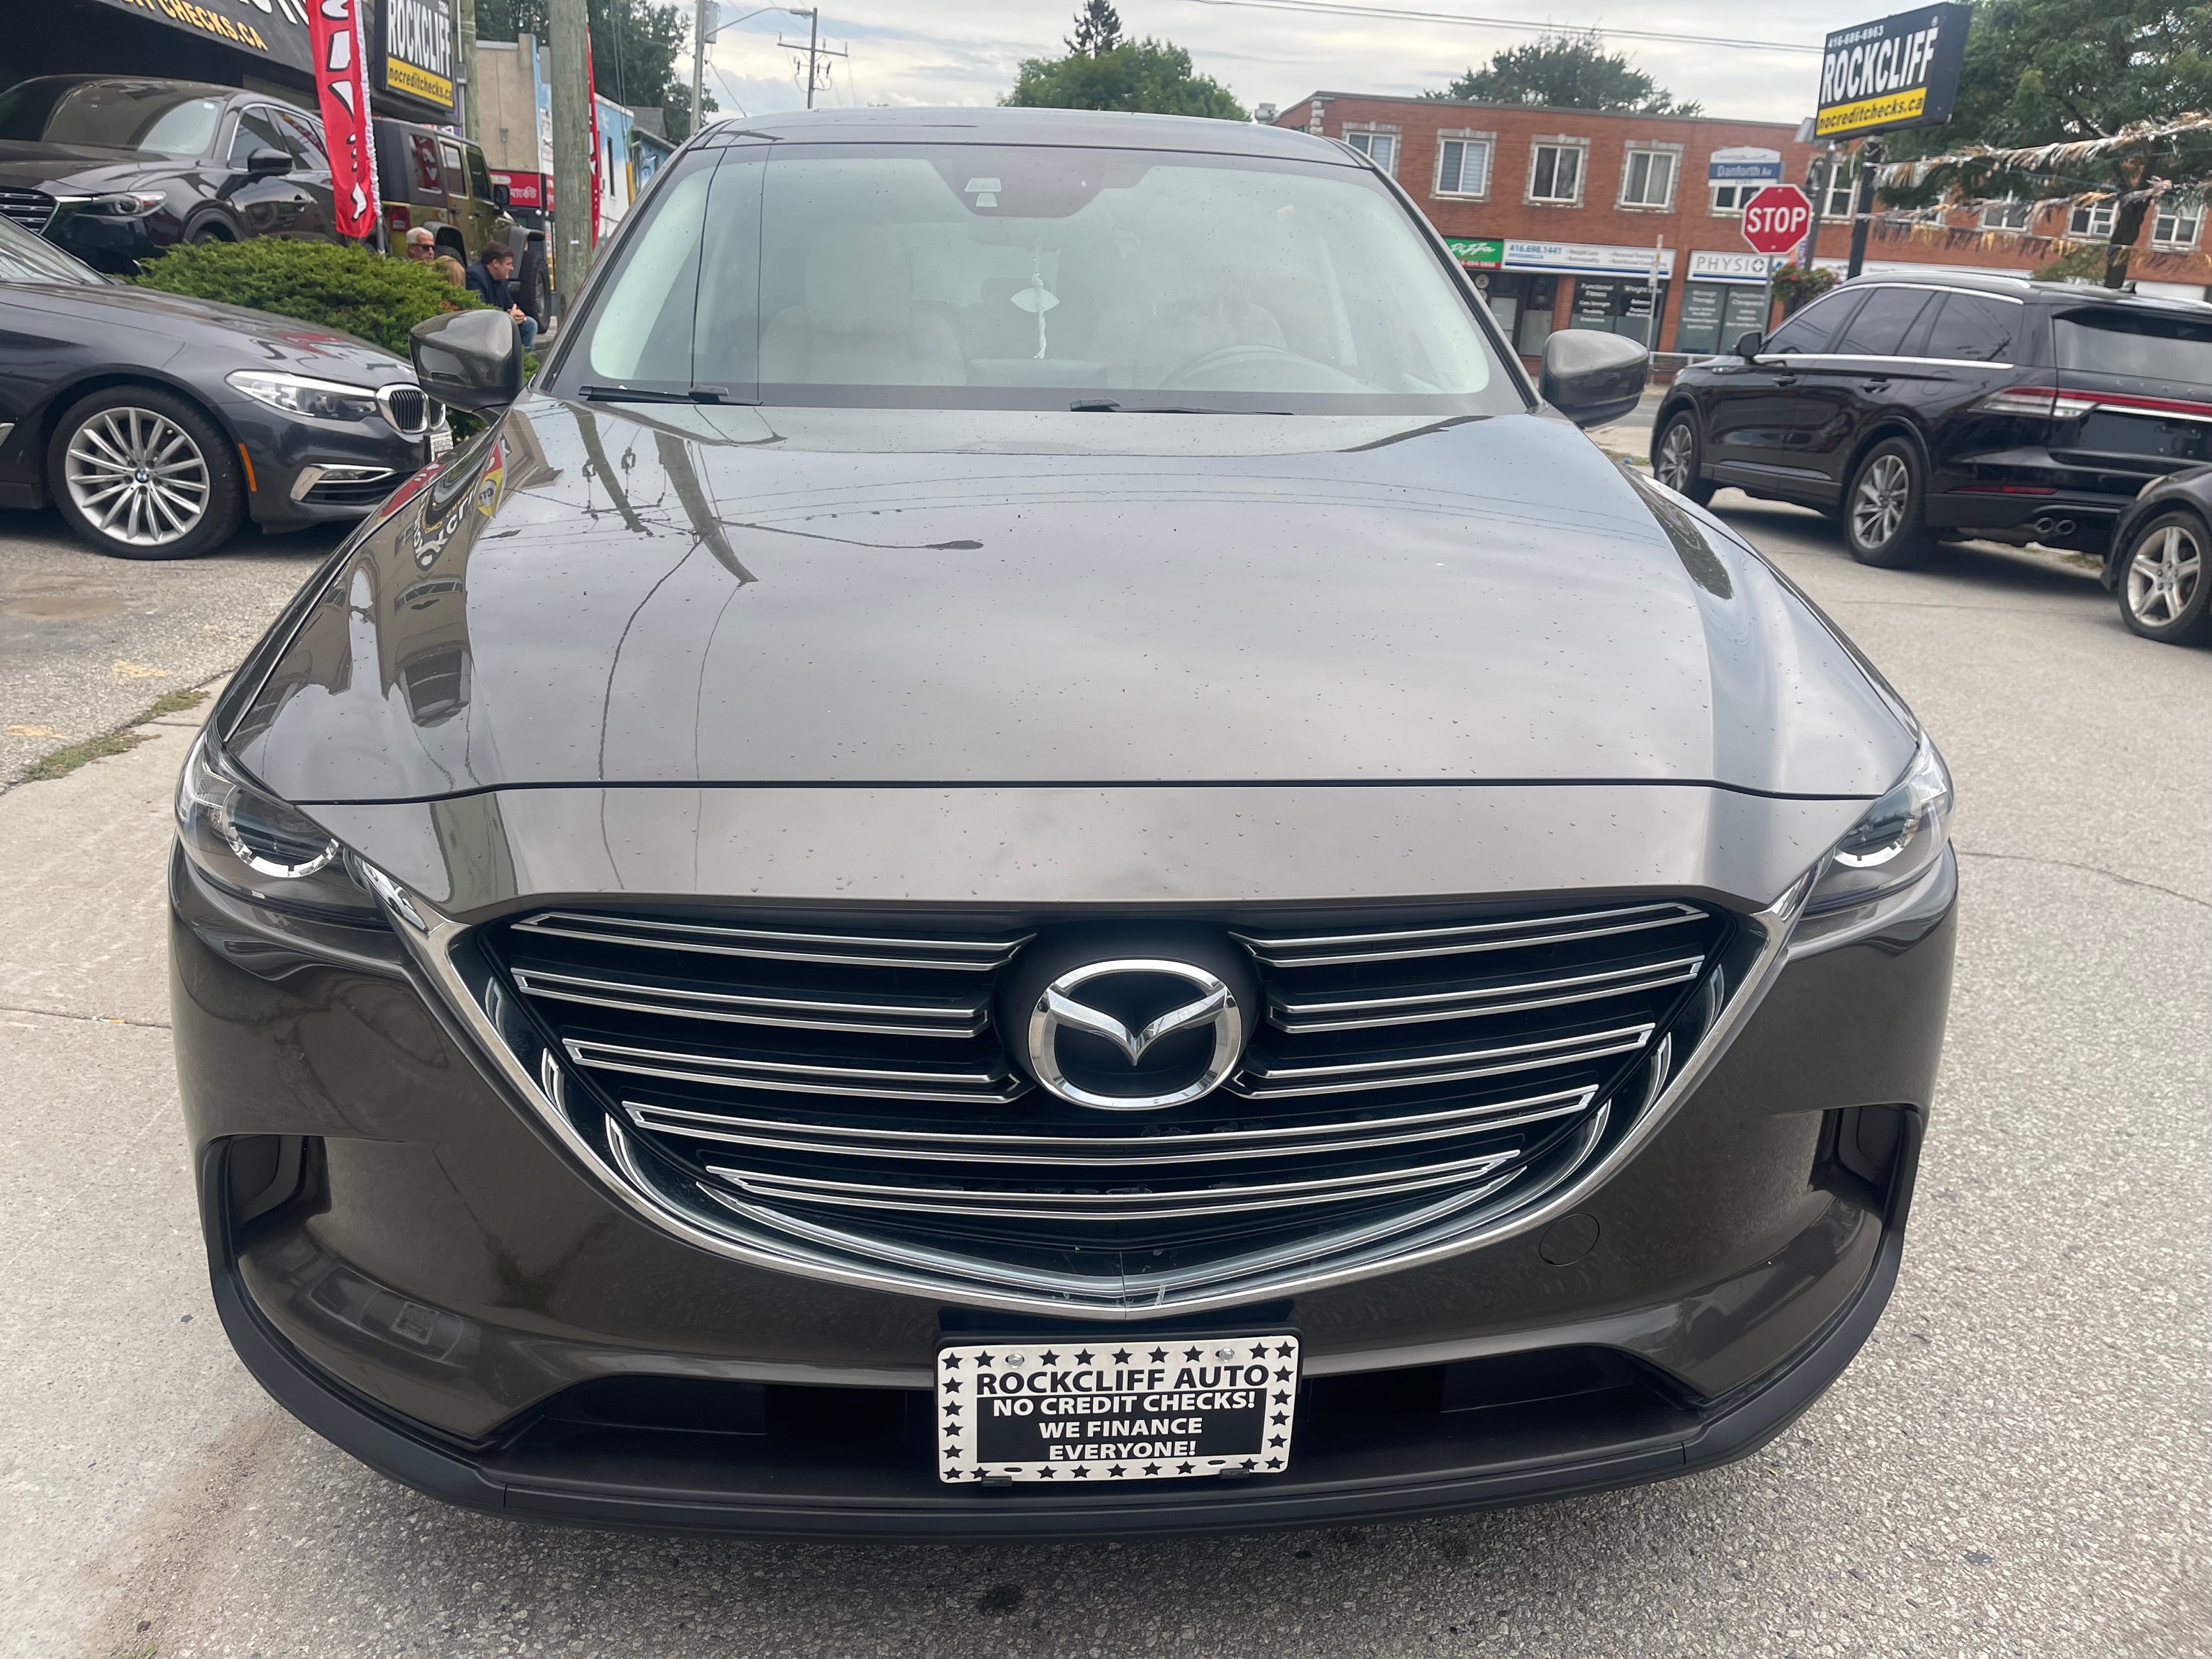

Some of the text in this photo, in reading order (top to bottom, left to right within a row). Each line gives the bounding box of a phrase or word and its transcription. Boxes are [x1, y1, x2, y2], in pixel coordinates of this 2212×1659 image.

[387, 0, 451, 78] ROCKCLIFF
[1820, 27, 1938, 104] ROCKCLIFF
[1817, 97, 1924, 130] nocreditchecks.ca
[1746, 207, 1807, 233] STOP
[976, 1364, 1269, 1395] ROCKCLIFF AUTO
[993, 1391, 1256, 1417] NO CREDIT CHECKS!
[1038, 1417, 1203, 1439] WE FINANCE
[1049, 1441, 1197, 1461] EVERYONE!
